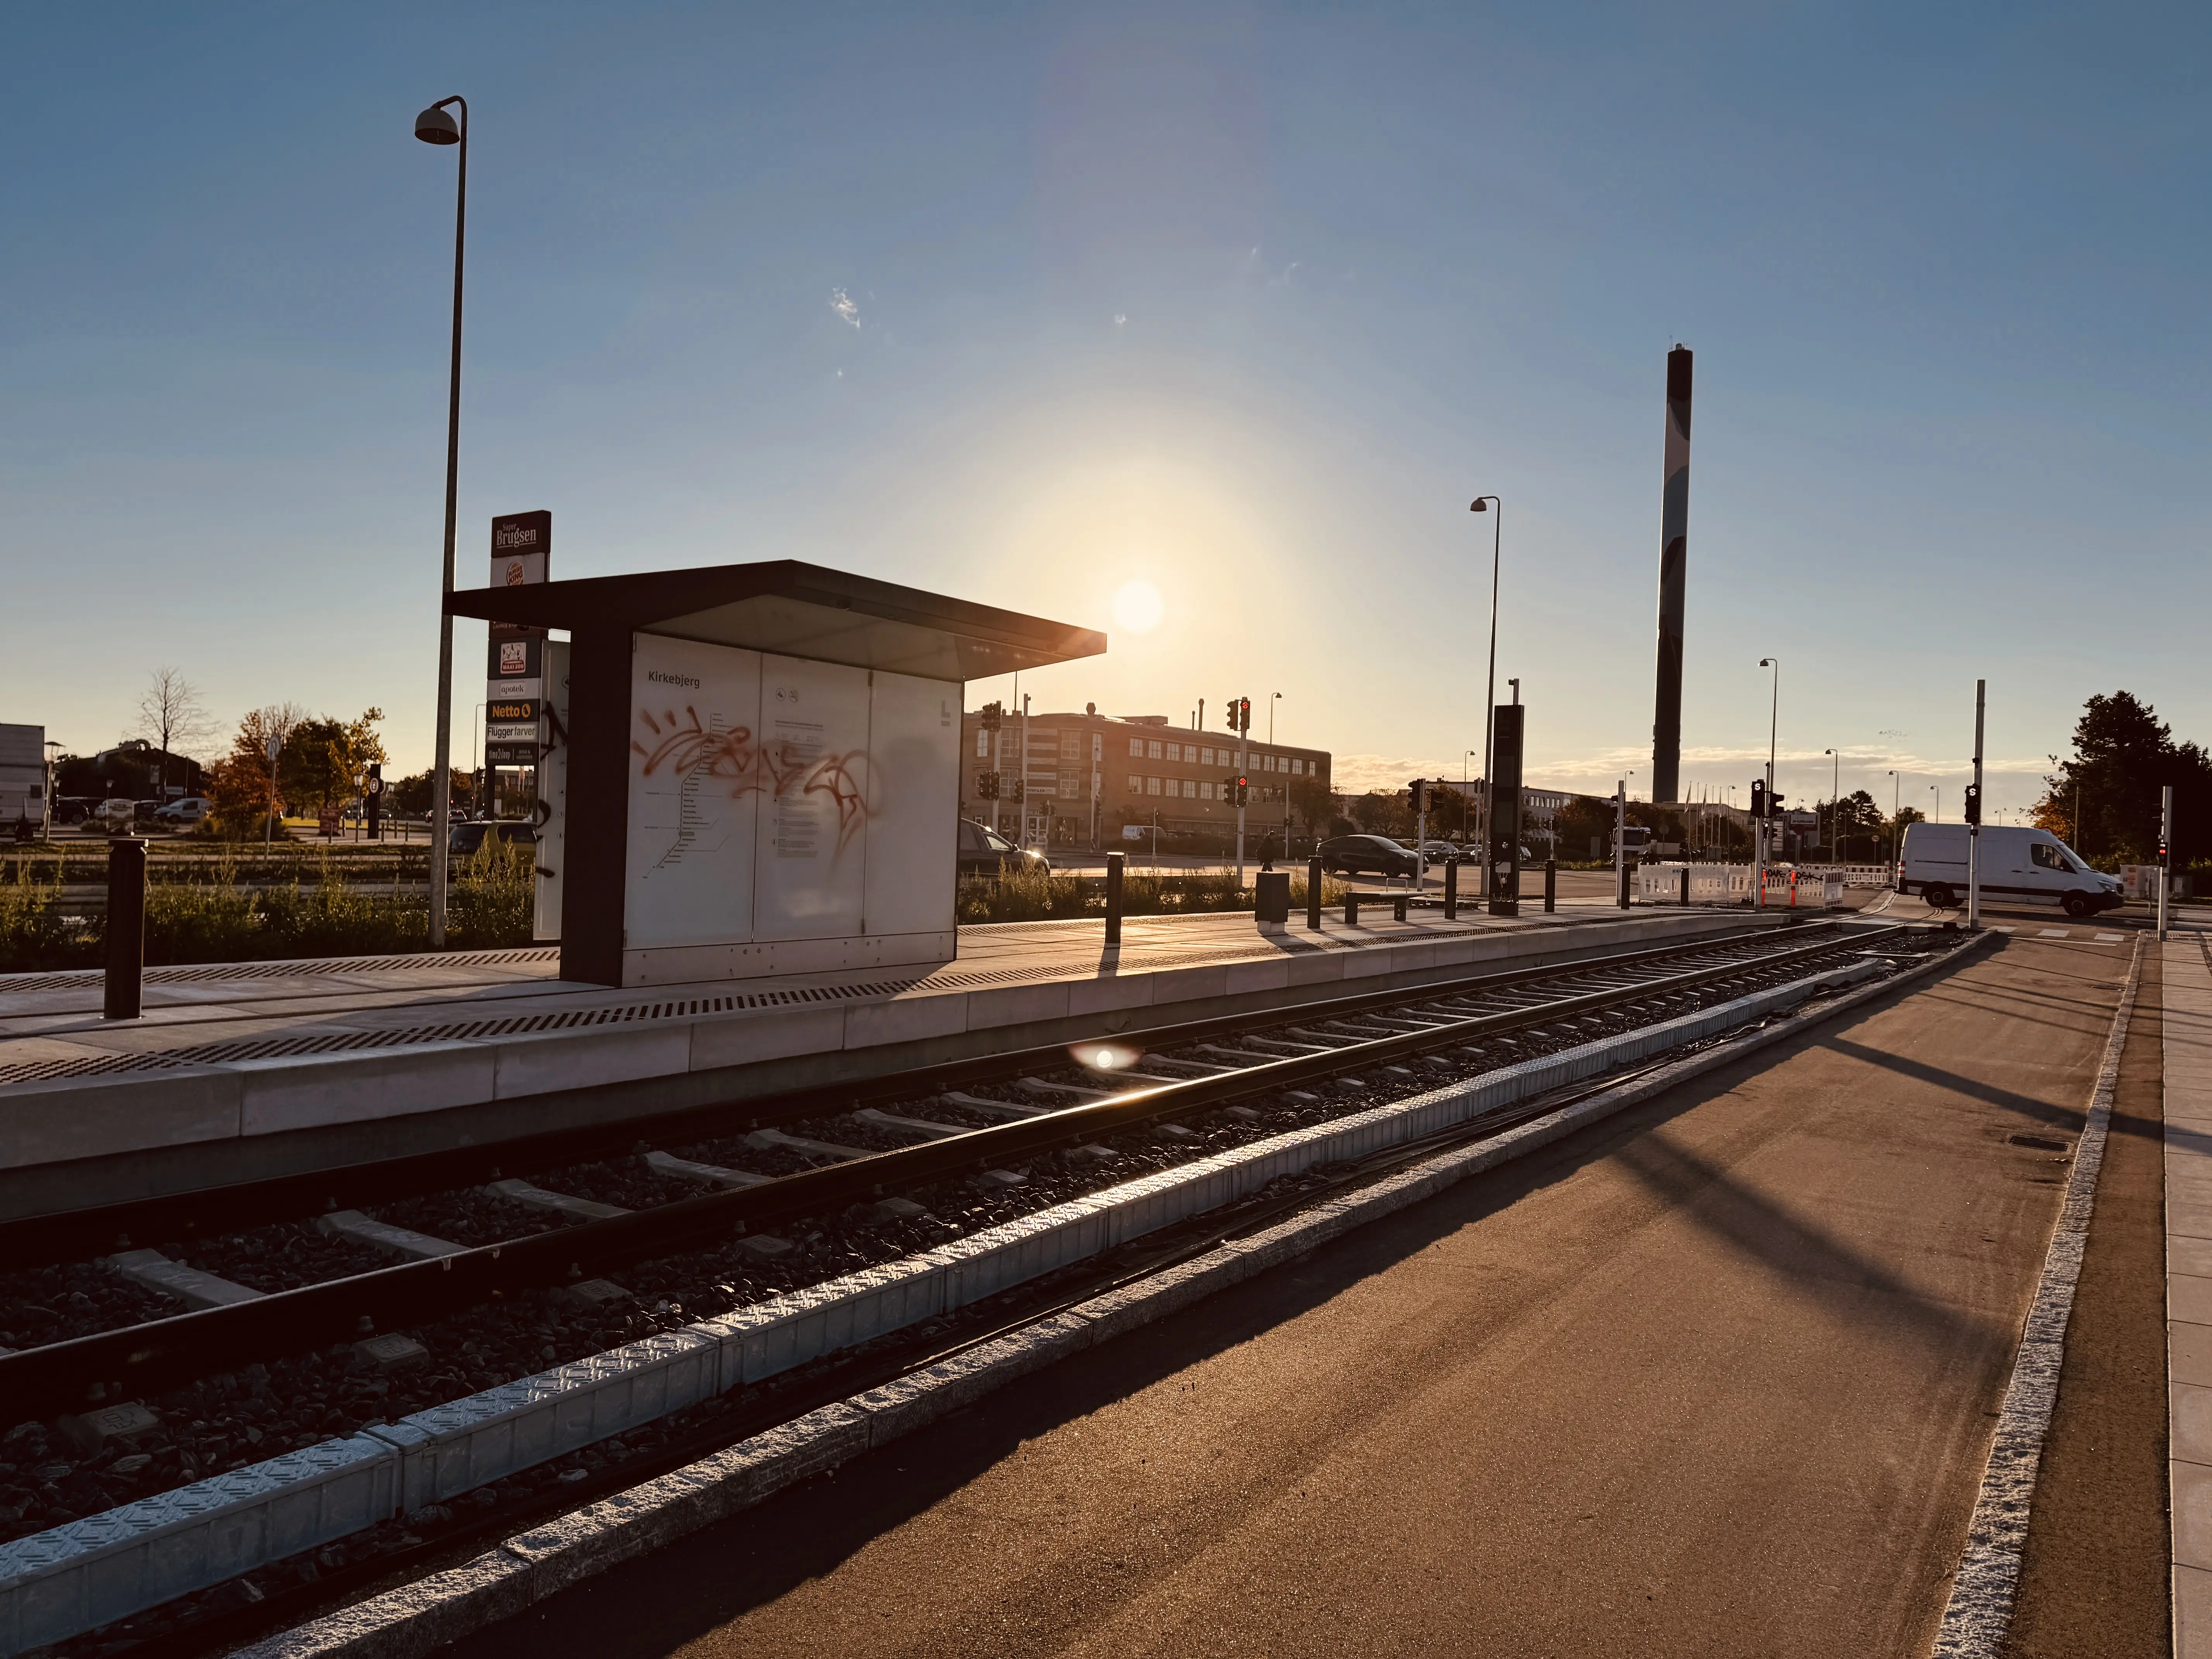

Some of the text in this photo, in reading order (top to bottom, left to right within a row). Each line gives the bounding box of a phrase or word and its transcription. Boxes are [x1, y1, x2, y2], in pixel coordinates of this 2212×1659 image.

[503, 523, 517, 532] Super
[496, 527, 536, 548] Brugsen
[509, 570, 523, 584] KING
[649, 670, 700, 689] Kirkebjerg
[501, 684, 524, 694] apotek
[493, 705, 520, 718] Netto
[488, 726, 535, 738] Flügger farver
[489, 748, 511, 761] time2sleep
[1969, 788, 1976, 796] S
